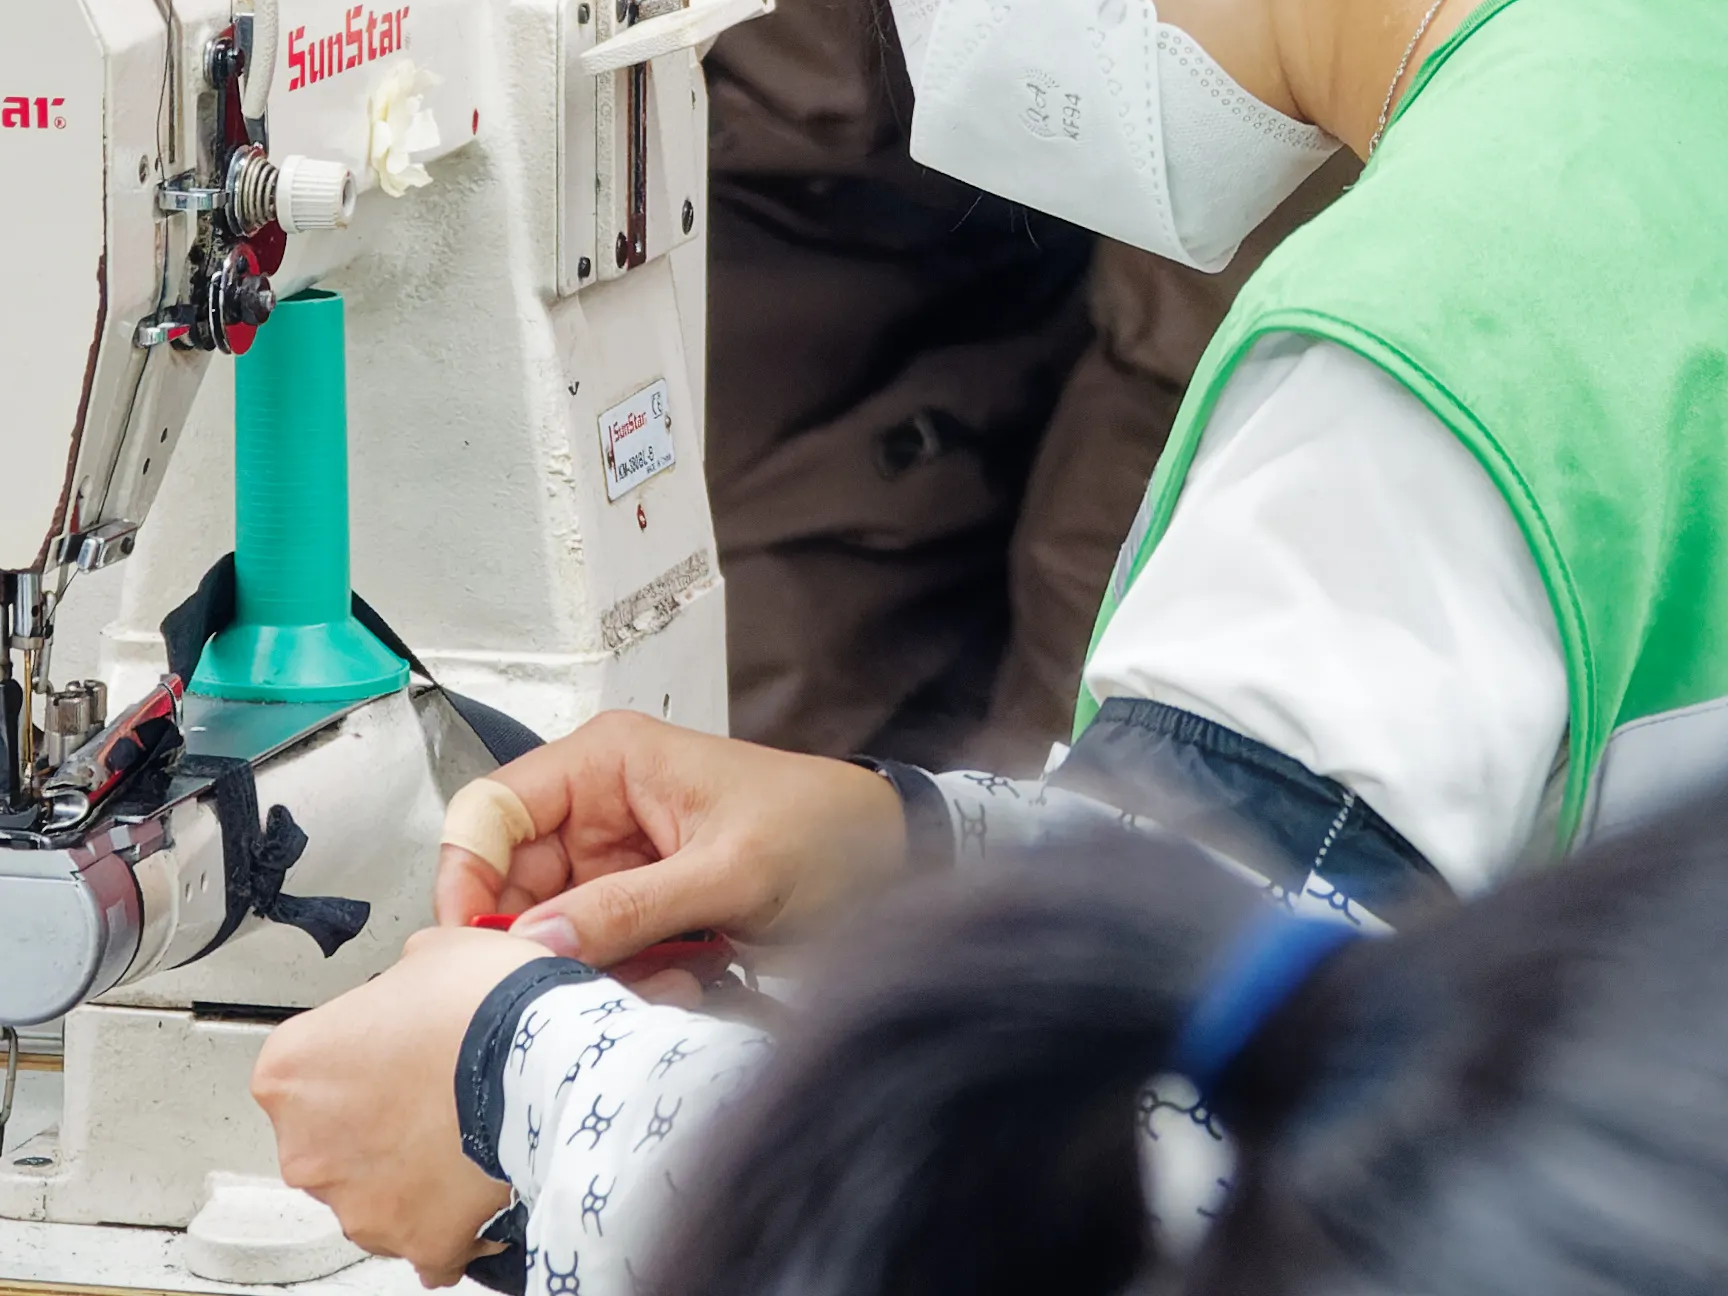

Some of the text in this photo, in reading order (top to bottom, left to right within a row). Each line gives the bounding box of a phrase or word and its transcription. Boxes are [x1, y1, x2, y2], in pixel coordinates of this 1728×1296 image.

[288, 4, 410, 92] SunStar
[1062, 93, 1081, 141] KF94
[613, 412, 646, 442] SunStar
